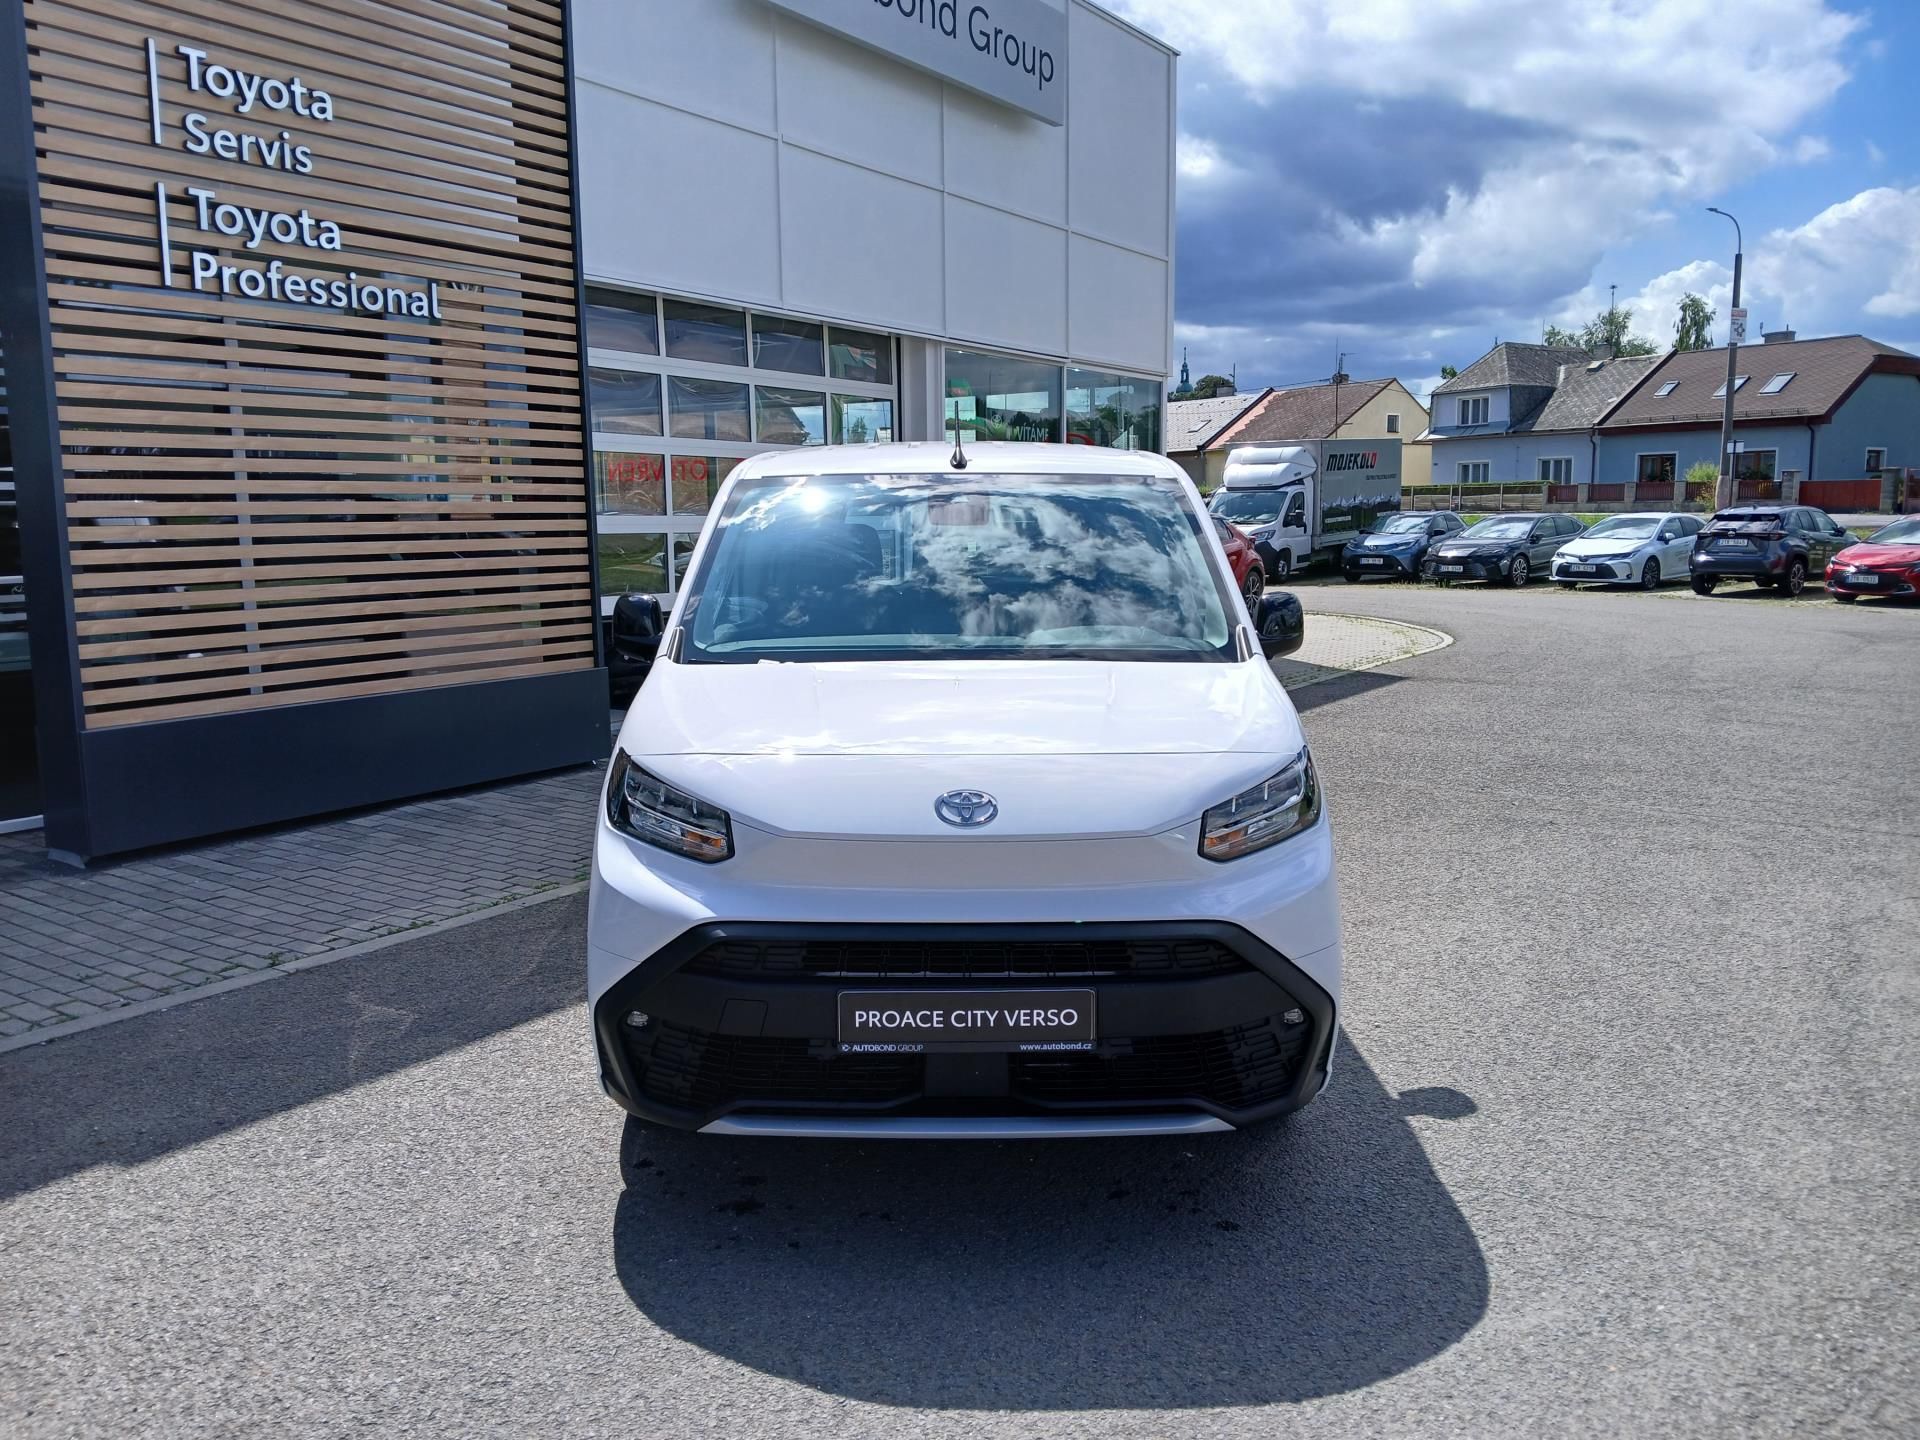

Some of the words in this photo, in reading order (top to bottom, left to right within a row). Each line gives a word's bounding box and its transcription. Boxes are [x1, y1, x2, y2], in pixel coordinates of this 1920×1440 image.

[968, 6, 1054, 91] Group
[178, 45, 333, 121] Toyota
[184, 113, 313, 173] Servis
[187, 187, 341, 250] Toyota
[192, 251, 442, 318] Professional
[1326, 452, 1377, 471] MOJEKOLO
[852, 1044, 897, 1052] AUTOBOND
[897, 1044, 924, 1052] GROUP
[855, 1010, 944, 1028] PROACE
[951, 1010, 999, 1028] CITY
[1004, 1008, 1079, 1027] VERSO
[1020, 1042, 1092, 1051] www.autobond.cz
